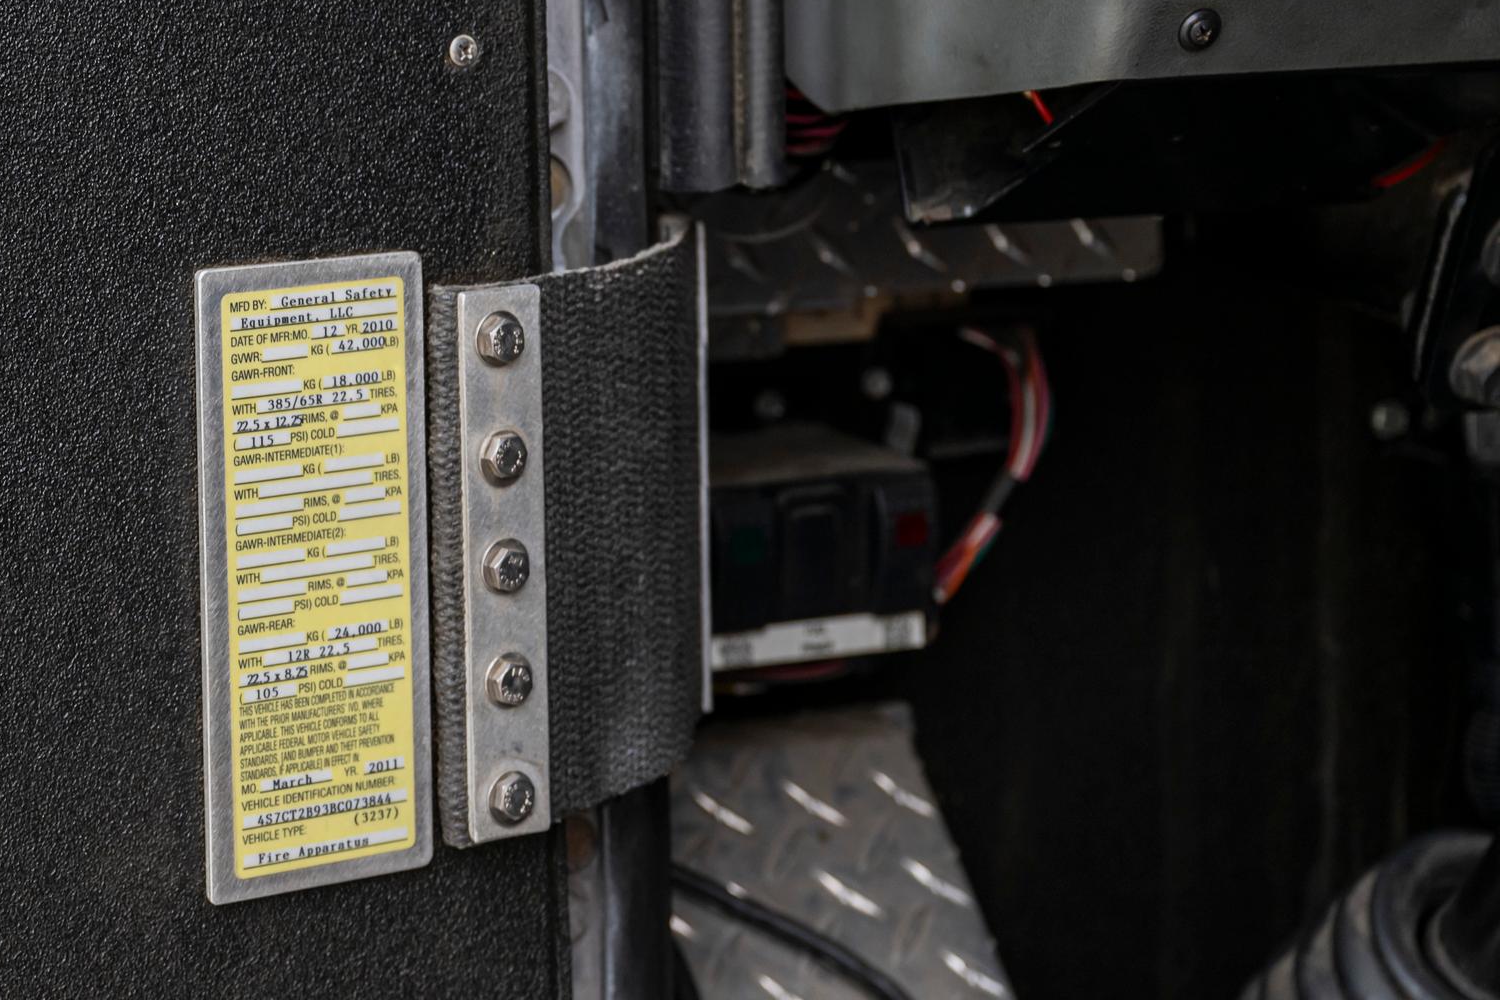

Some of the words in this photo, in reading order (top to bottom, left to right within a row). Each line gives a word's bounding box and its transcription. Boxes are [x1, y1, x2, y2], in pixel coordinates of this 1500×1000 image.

[230, 300, 250, 313] MFD
[252, 299, 267, 310] BY:
[281, 292, 336, 307] General
[345, 288, 391, 299] Safety
[331, 307, 353, 318] LLC
[231, 336, 254, 347] DATE
[256, 334, 268, 344] OF
[323, 326, 338, 337] 12
[363, 320, 392, 332] 2010
[311, 344, 324, 355] KG
[231, 365, 295, 381] GAWR-FRONT:
[304, 379, 315, 389] KG
[381, 370, 395, 381] LB)
[233, 404, 257, 415] WITH
[268, 396, 323, 410] 385/65R
[333, 391, 363, 403] 22.5
[237, 419, 260, 433] 22.5
[263, 421, 270, 430] x
[381, 404, 397, 414] KPA
[251, 435, 274, 447] 115
[290, 430, 308, 443] PSI)
[311, 429, 335, 440] COLD
[238, 619, 295, 636] GAWR-REAR:
[307, 631, 319, 641] KG
[389, 619, 402, 630] LB)
[238, 657, 262, 669] WITH
[288, 650, 310, 662] 12R
[320, 643, 350, 656] 22.5
[247, 672, 270, 686] 22.5
[274, 673, 280, 681] x
[285, 666, 308, 679] 8.25
[389, 651, 405, 661] KPA
[256, 687, 278, 699] 105
[299, 681, 317, 694] PSI)
[319, 678, 342, 690] COLD
[273, 775, 313, 790] March
[369, 758, 398, 773] 2011
[242, 797, 279, 811] VEHICLE
[283, 785, 353, 804] IDENTIFICATION
[354, 807, 399, 825] (3237)
[243, 829, 279, 845] VEHICLE
[258, 850, 290, 864] Fire
[299, 836, 369, 857] Apparatus
